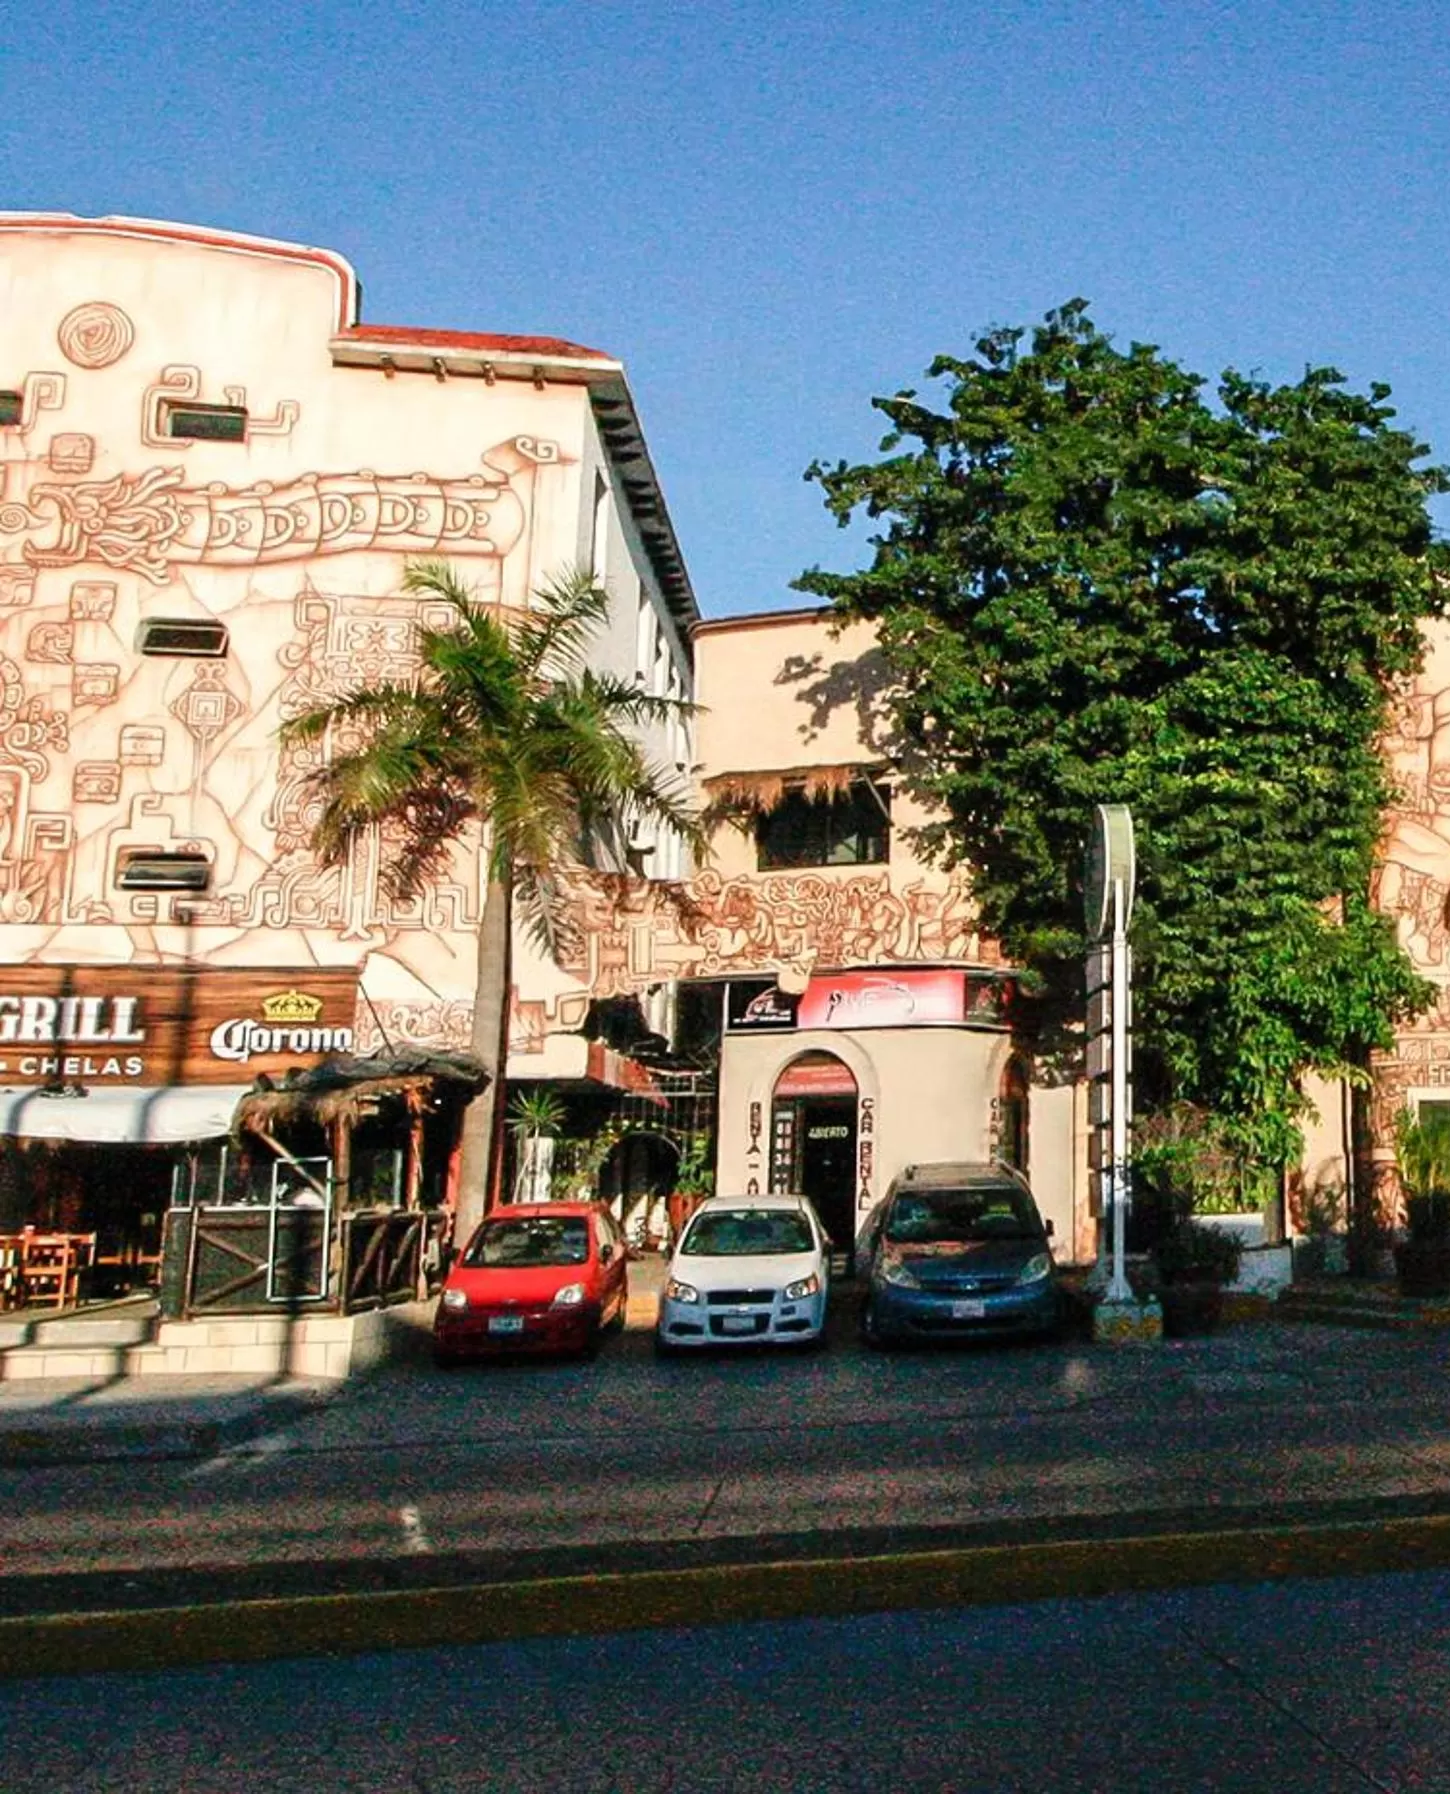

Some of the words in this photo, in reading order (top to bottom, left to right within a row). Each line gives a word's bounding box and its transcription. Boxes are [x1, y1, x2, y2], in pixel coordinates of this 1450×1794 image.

[0, 996, 145, 1041] GRILL
[210, 1018, 353, 1063] Corona
[20, 1056, 143, 1075] CHELAS
[746, 1101, 762, 1154] RENTA
[861, 1097, 875, 1133] CAR
[859, 1141, 873, 1210] RENTAL
